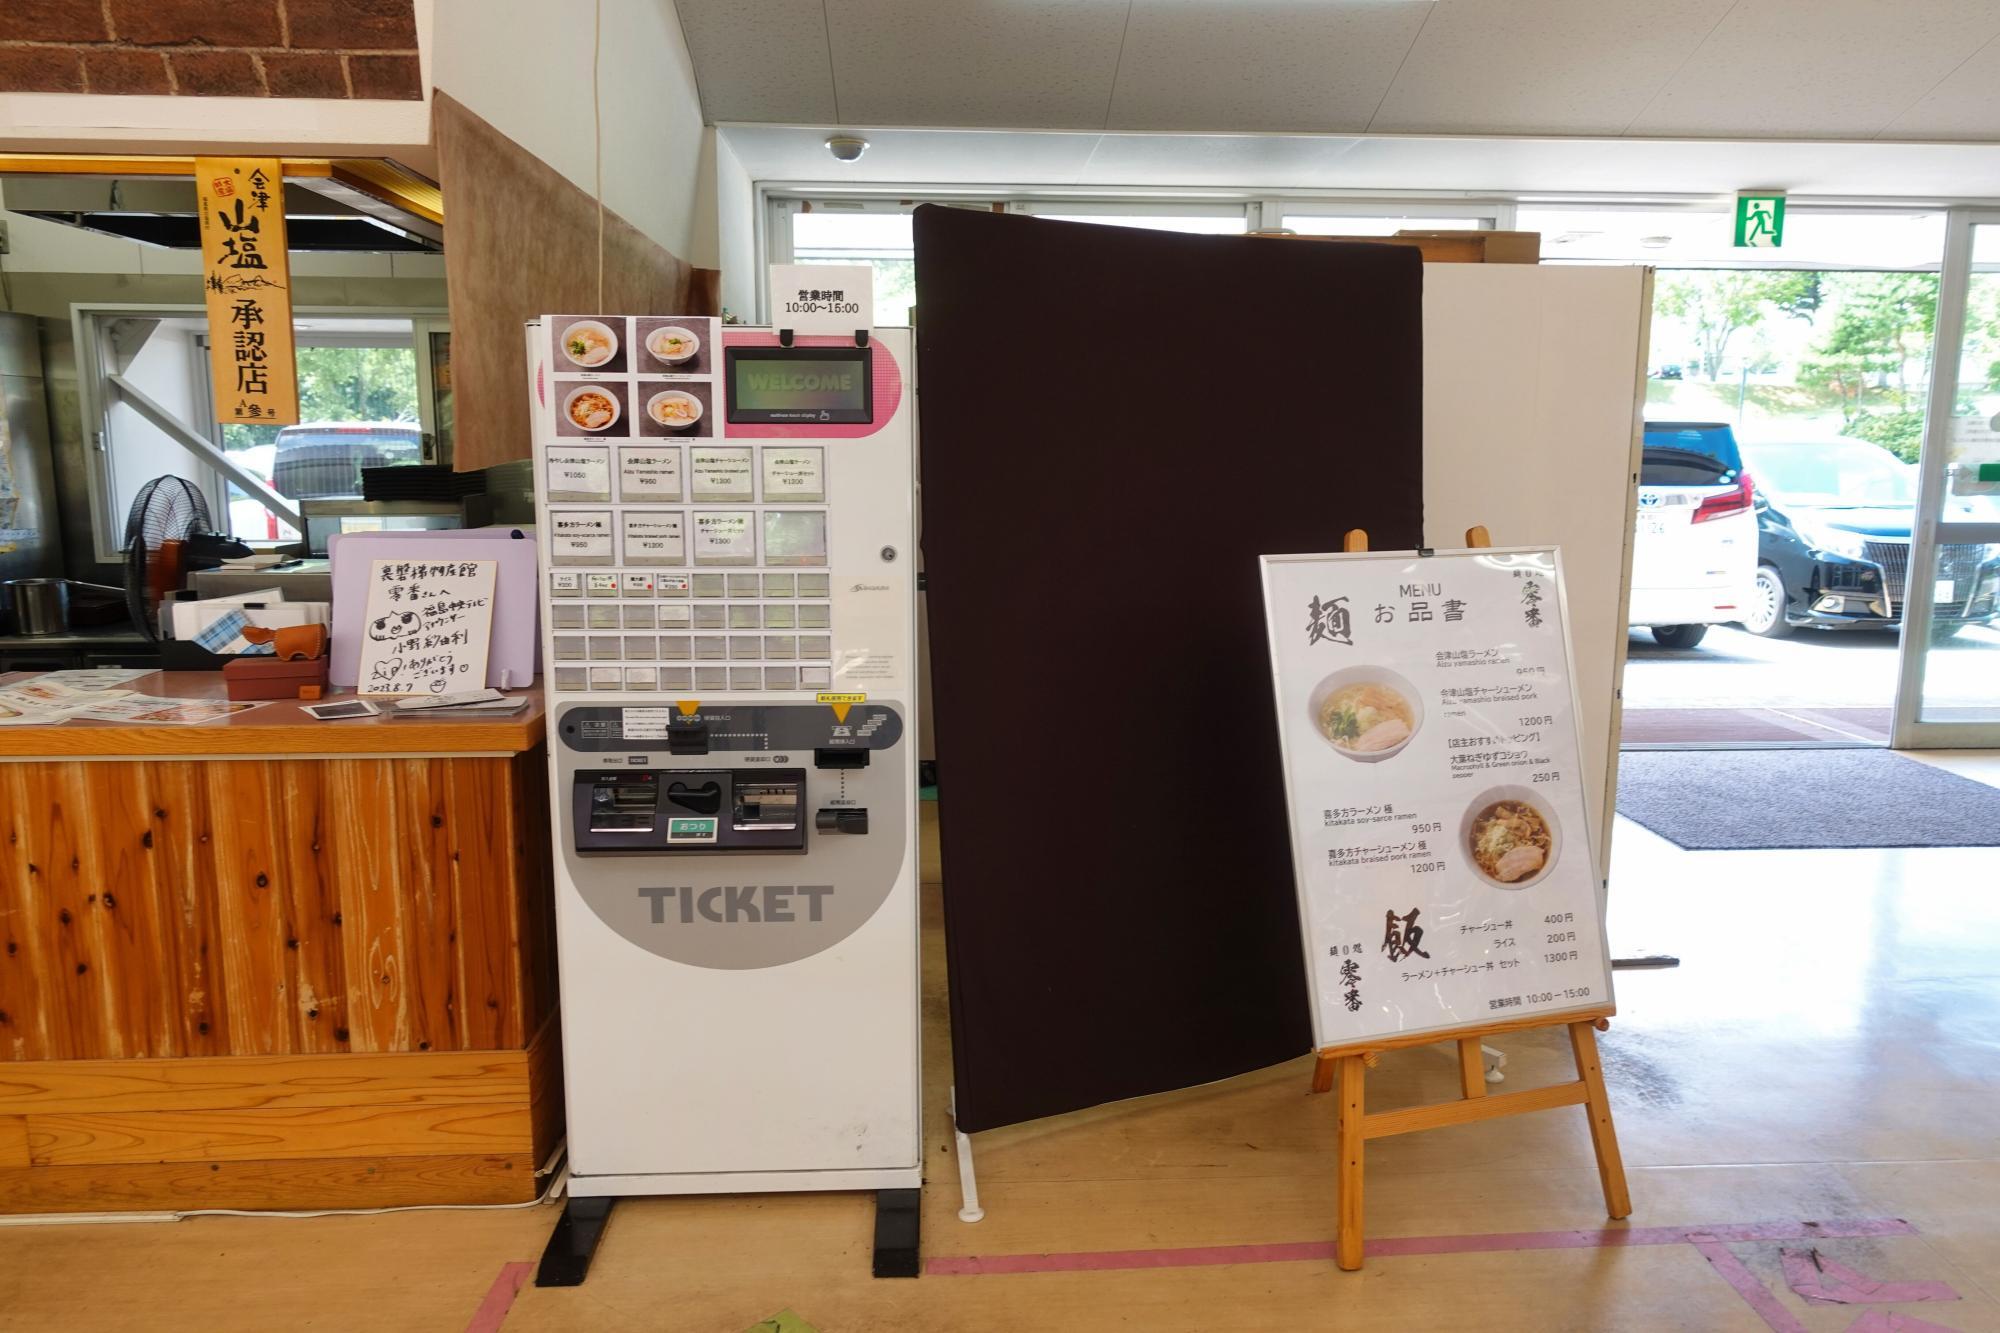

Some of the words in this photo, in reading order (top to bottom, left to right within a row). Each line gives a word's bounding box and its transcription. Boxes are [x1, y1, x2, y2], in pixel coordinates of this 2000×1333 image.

[248, 168, 270, 212] 会津
[217, 198, 268, 270] 山塩
[798, 290, 844, 302] 営業時間
[231, 299, 268, 395] 承認店
[747, 373, 852, 391] WELCOME
[1399, 583, 1441, 598] MENU
[1374, 599, 1467, 624] お品書
[1306, 595, 1353, 646] 麺
[1532, 771, 1560, 782] 250円
[1411, 822, 1442, 834] 950円
[1410, 861, 1446, 874] 1200円
[638, 885, 834, 924] TICKET
[1544, 912, 1574, 924] 400円
[1381, 907, 1431, 963] 飯
[1547, 931, 1576, 944] 200円
[1493, 938, 1517, 949] ライス
[1544, 950, 1578, 963] 1300円
[1489, 996, 1522, 1010] 営業時間
